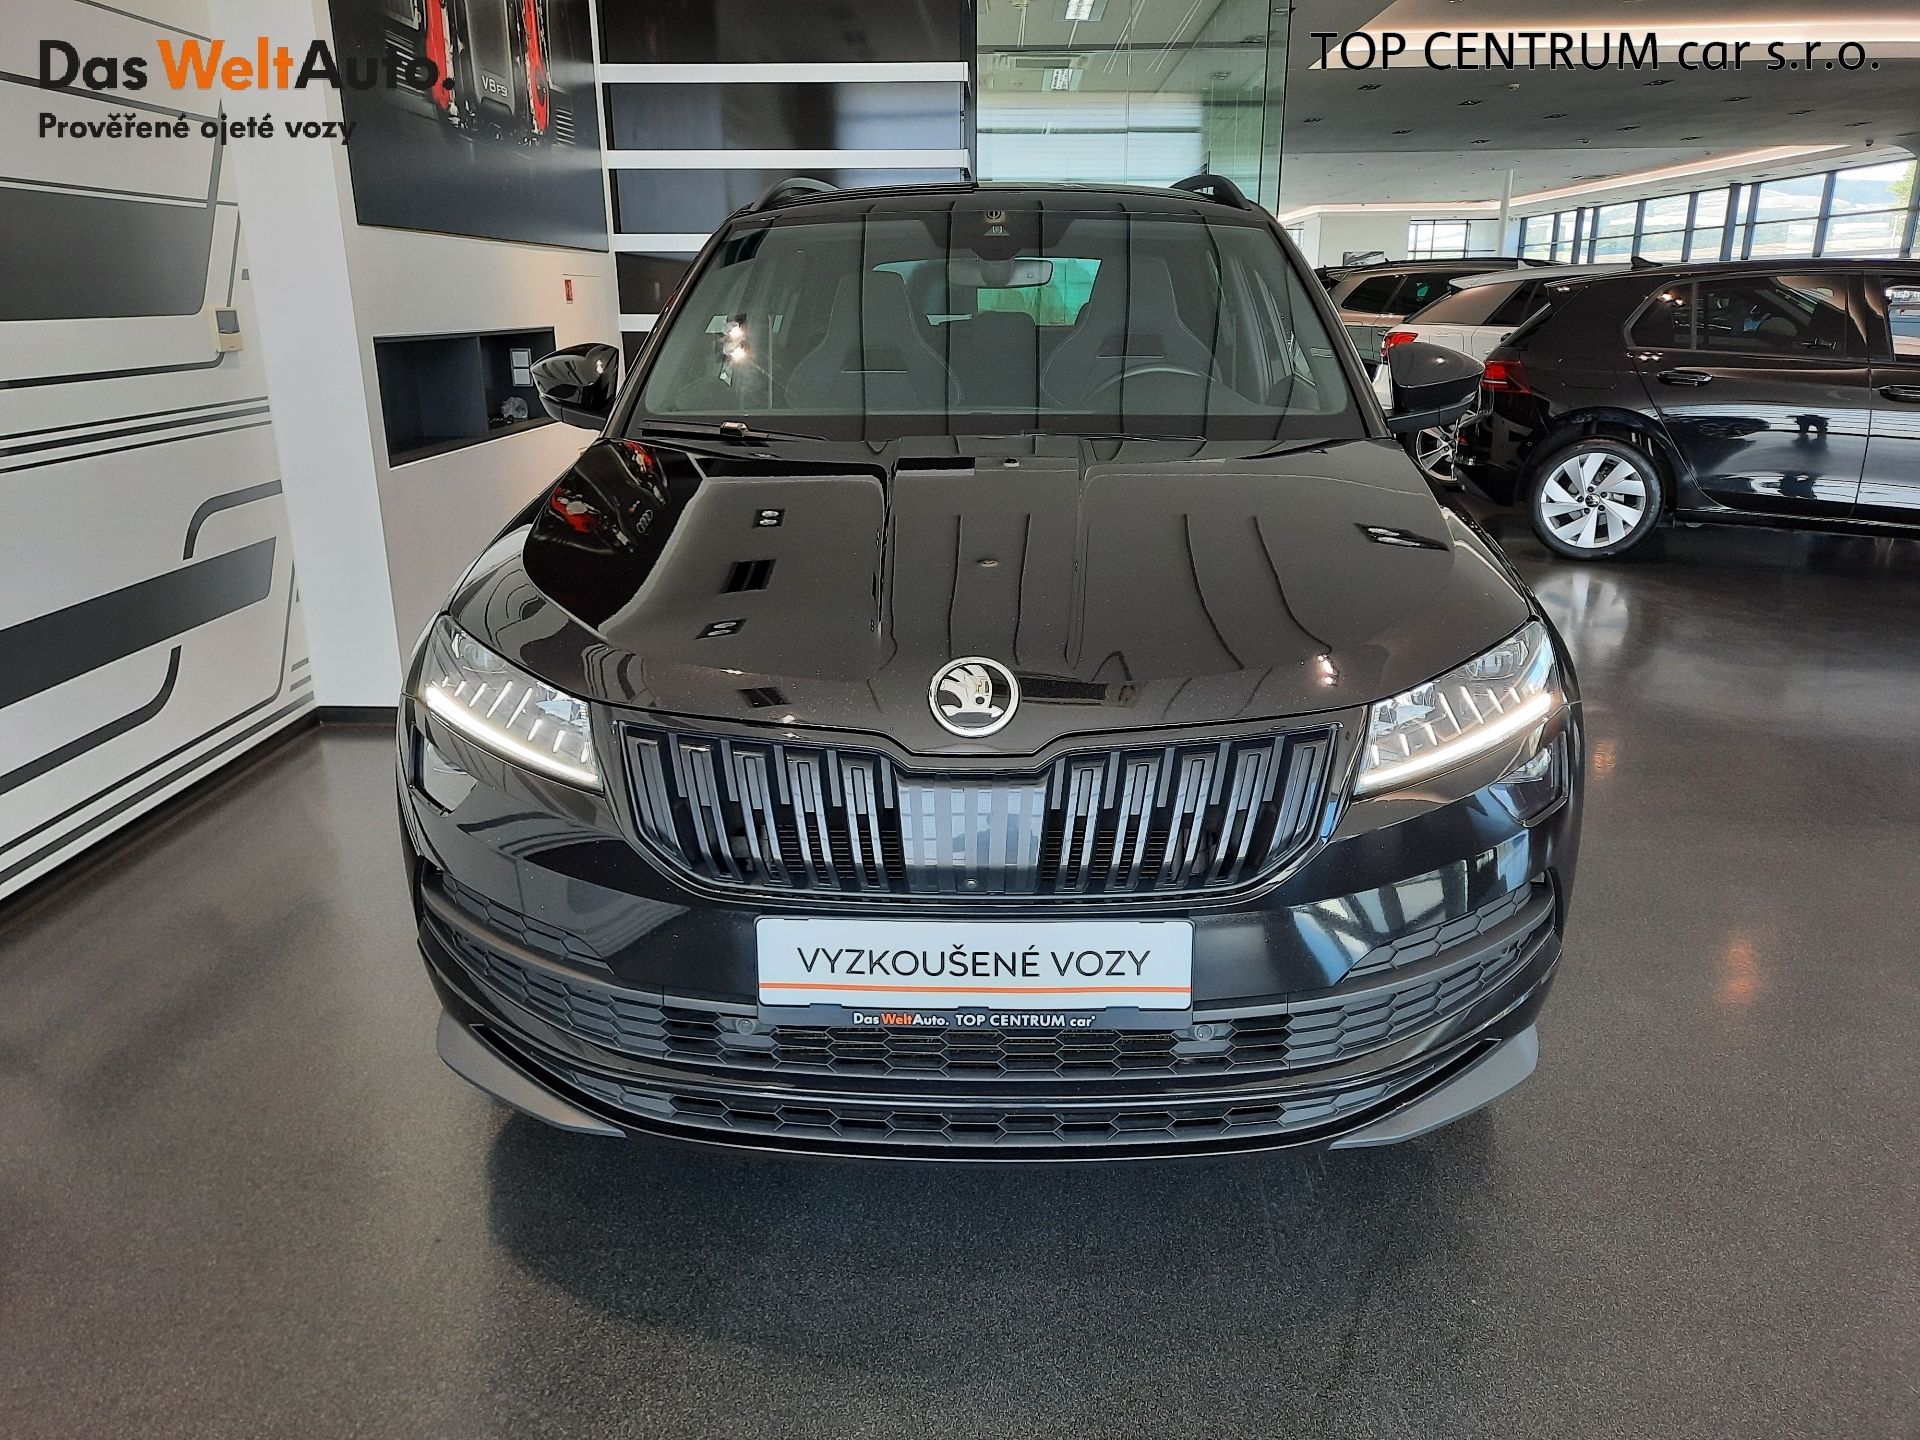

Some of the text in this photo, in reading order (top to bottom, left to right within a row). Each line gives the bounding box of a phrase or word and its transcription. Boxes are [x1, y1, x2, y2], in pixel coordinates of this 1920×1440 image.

[481, 75, 496, 93] V8
[796, 944, 1152, 977] VYZKOUŠENÉ VOZY
[853, 1012, 880, 1025] Das
[955, 1014, 986, 1027] TOP
[989, 1014, 1066, 1028] CENTRUM
